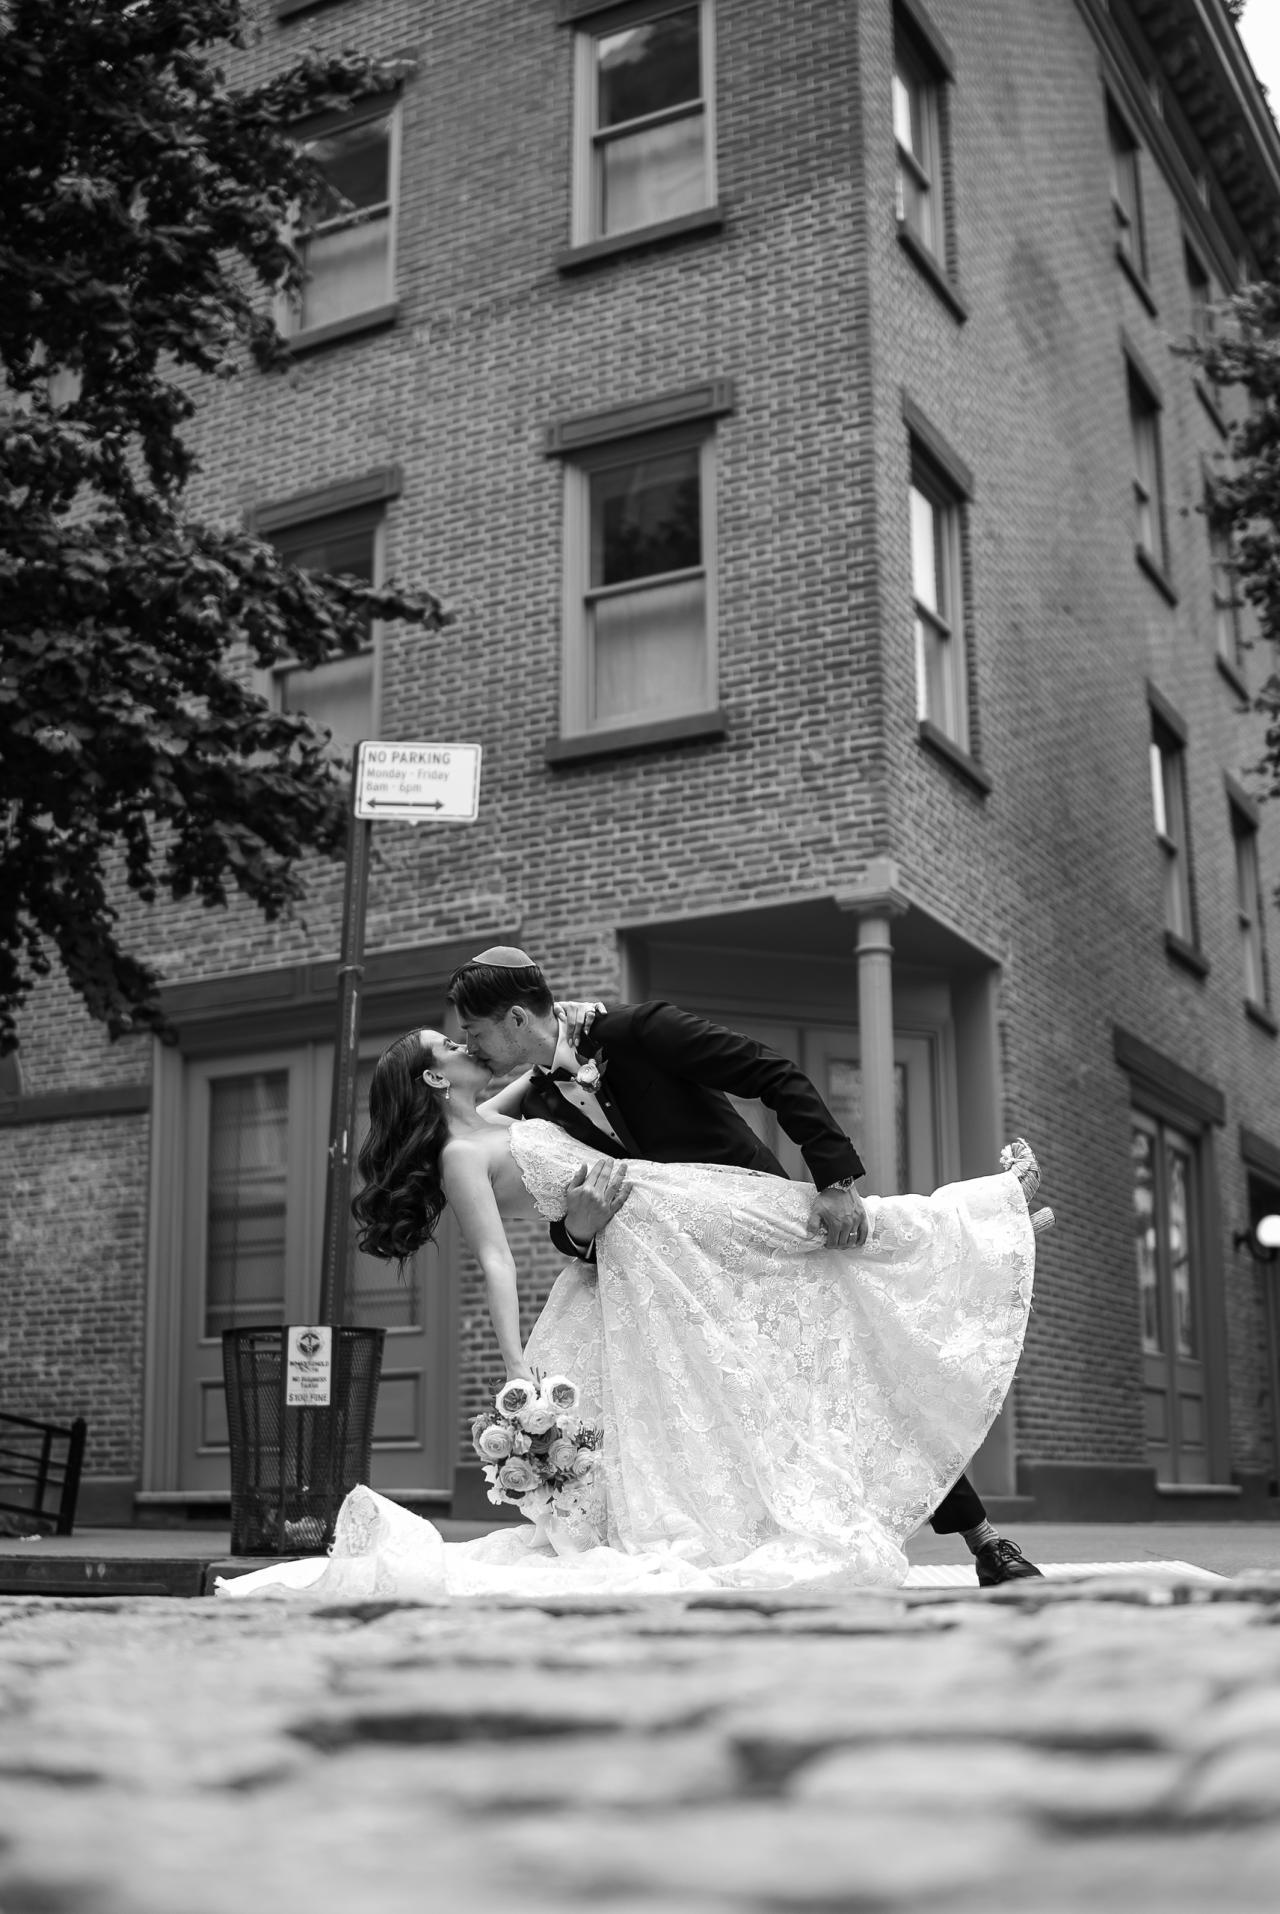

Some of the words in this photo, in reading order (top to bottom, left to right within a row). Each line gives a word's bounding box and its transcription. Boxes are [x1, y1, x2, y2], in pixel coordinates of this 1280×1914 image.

[368, 750, 388, 763] NO
[391, 750, 451, 765] PARKING
[367, 767, 407, 780] Monday
[417, 767, 450, 782] Friday
[399, 783, 422, 794] 6pm
